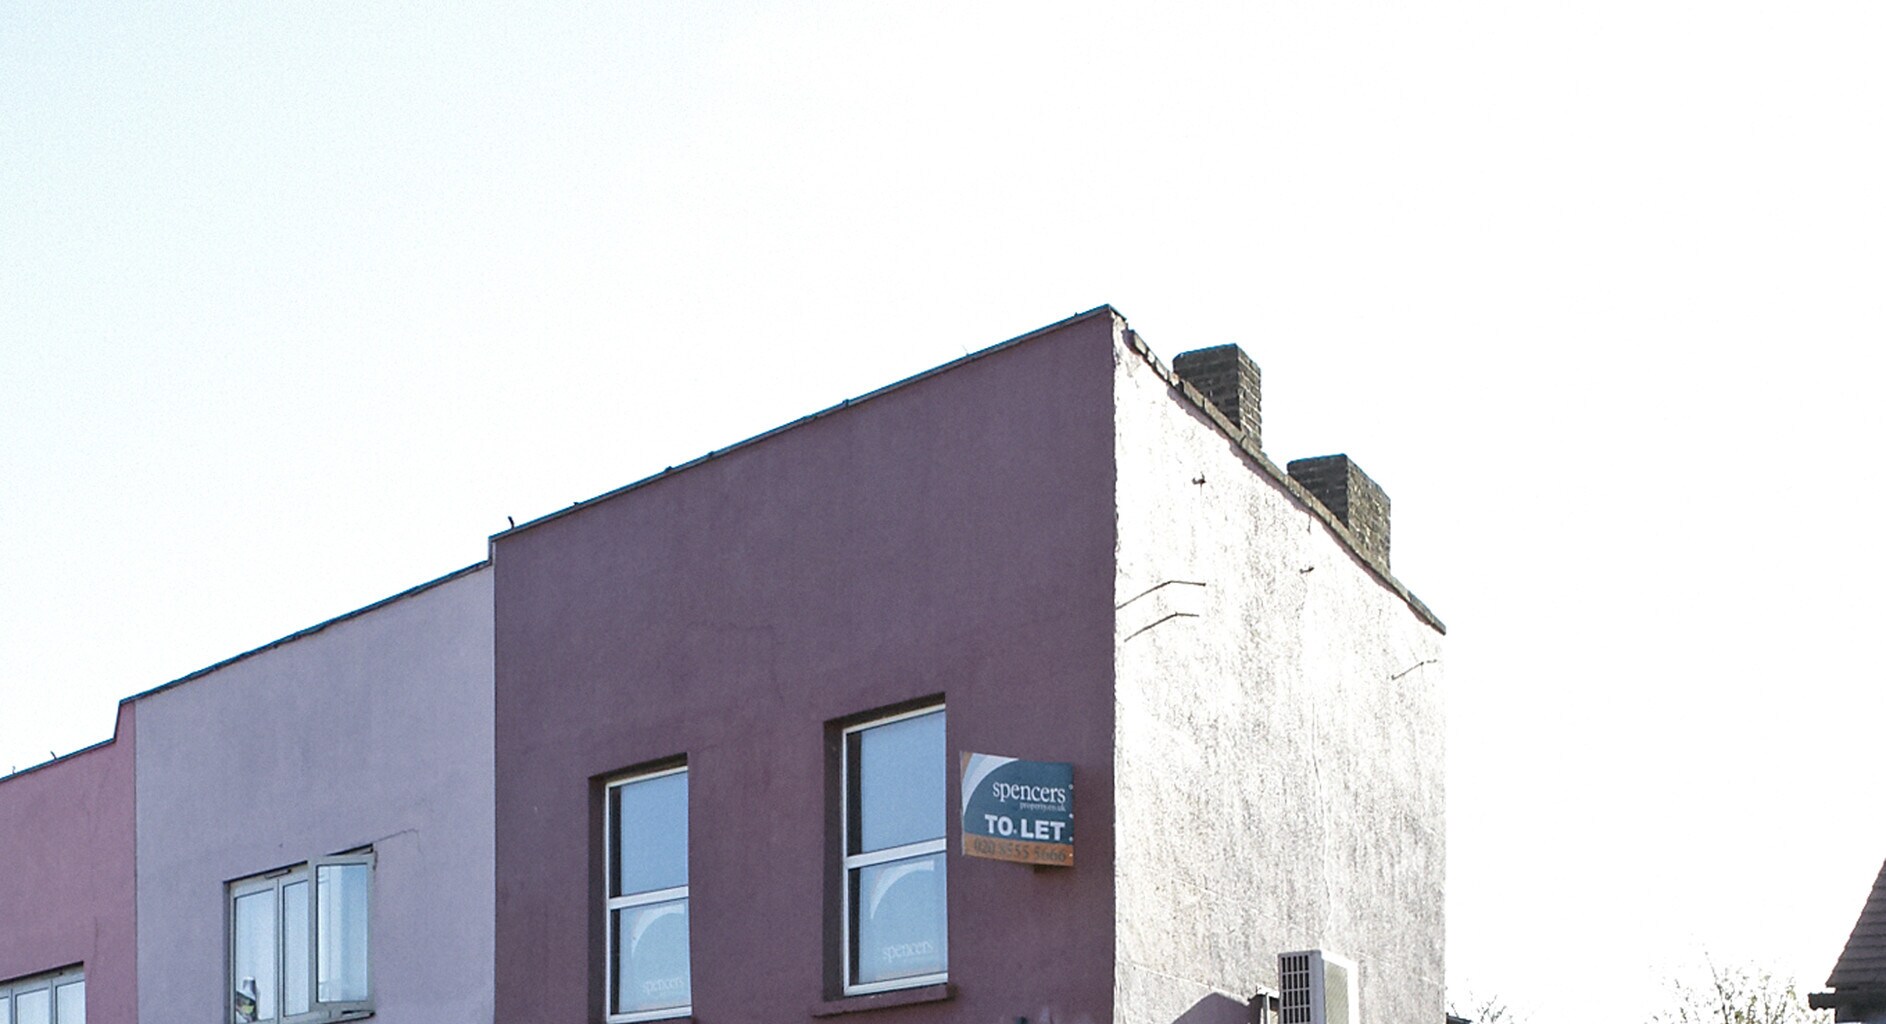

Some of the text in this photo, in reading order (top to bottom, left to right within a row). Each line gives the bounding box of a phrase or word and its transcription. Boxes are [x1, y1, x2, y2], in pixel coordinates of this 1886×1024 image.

[992, 781, 1067, 805] spencers
[984, 814, 1066, 841] TO LET
[974, 839, 1067, 862] 020 8555 5666
[882, 939, 935, 964] spencers
[643, 976, 685, 997] spencers
